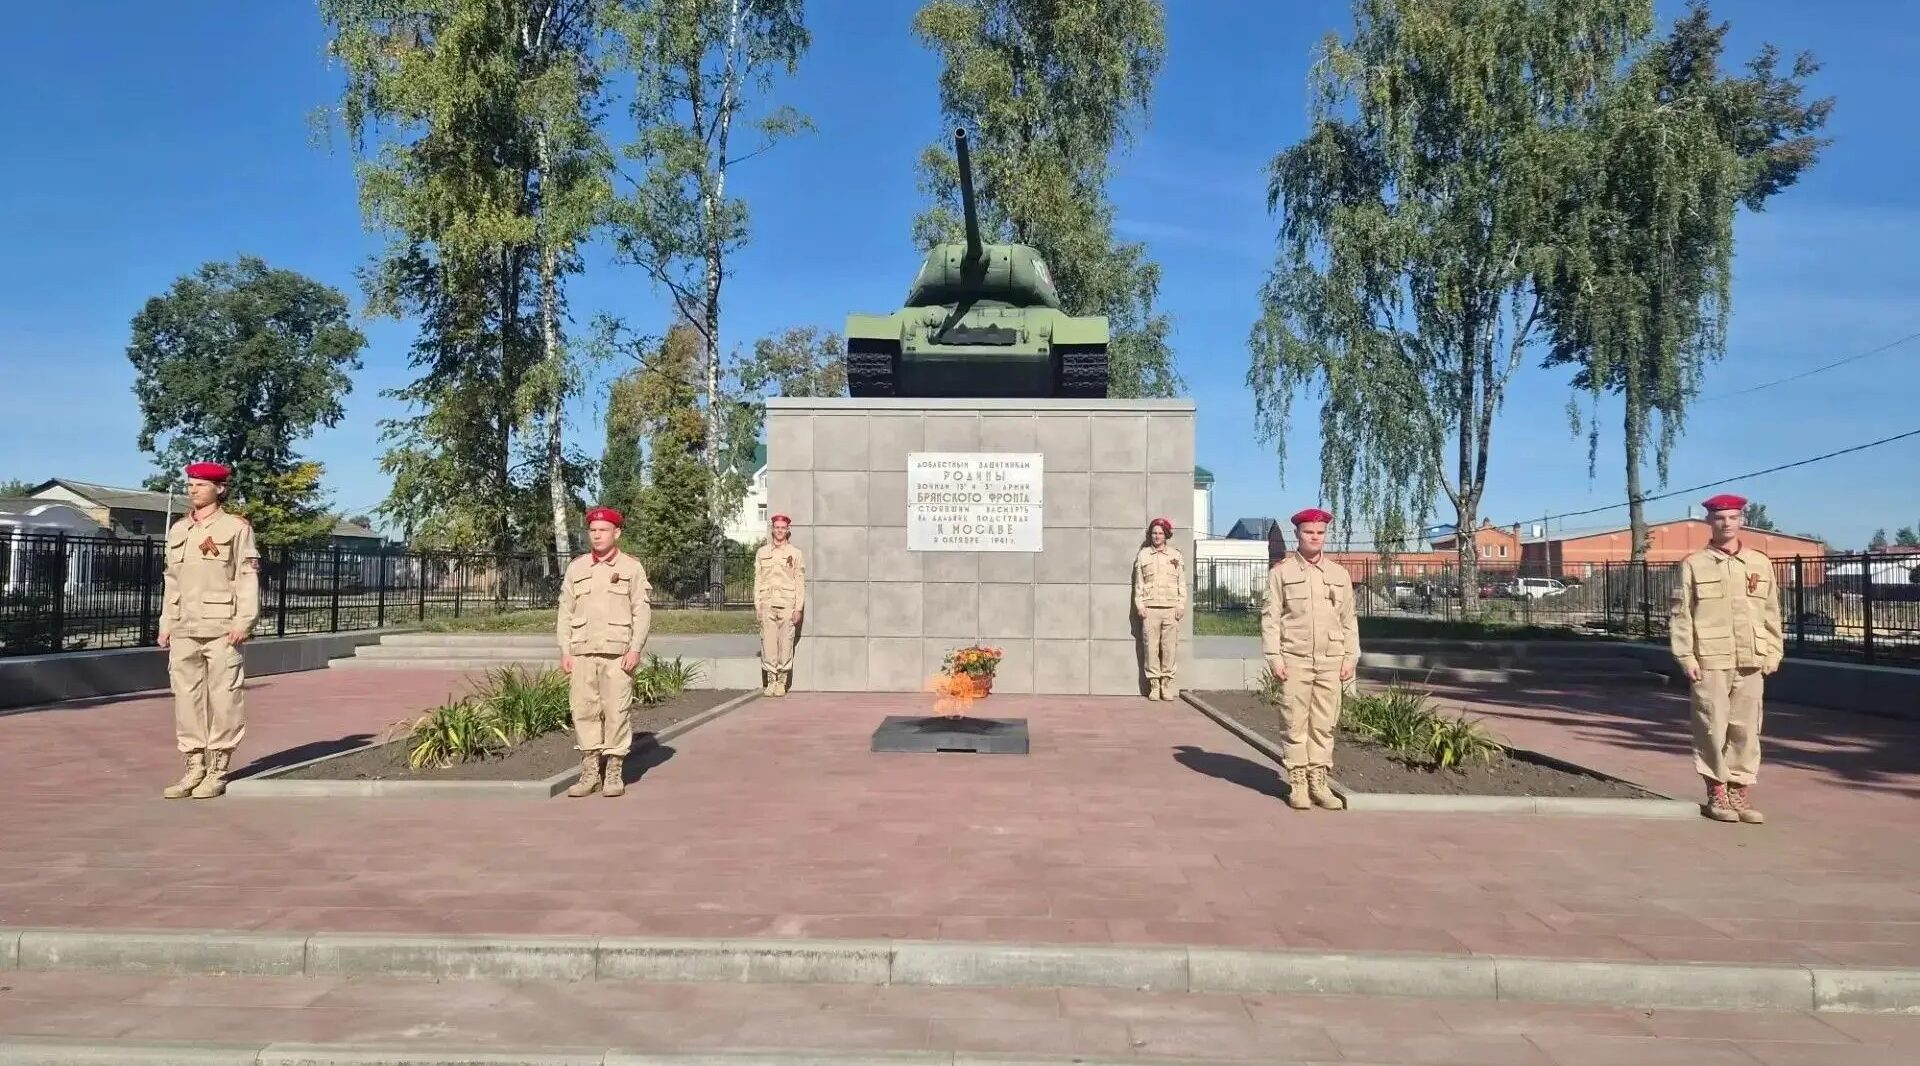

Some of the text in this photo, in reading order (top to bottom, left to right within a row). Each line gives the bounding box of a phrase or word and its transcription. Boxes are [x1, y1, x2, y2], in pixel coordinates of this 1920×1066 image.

[944, 471, 1005, 481] РОДИНЫ
[918, 493, 1029, 503] БРЯНСКОГО ФРОНТА
[938, 524, 1013, 534] К МОСКВЕ
